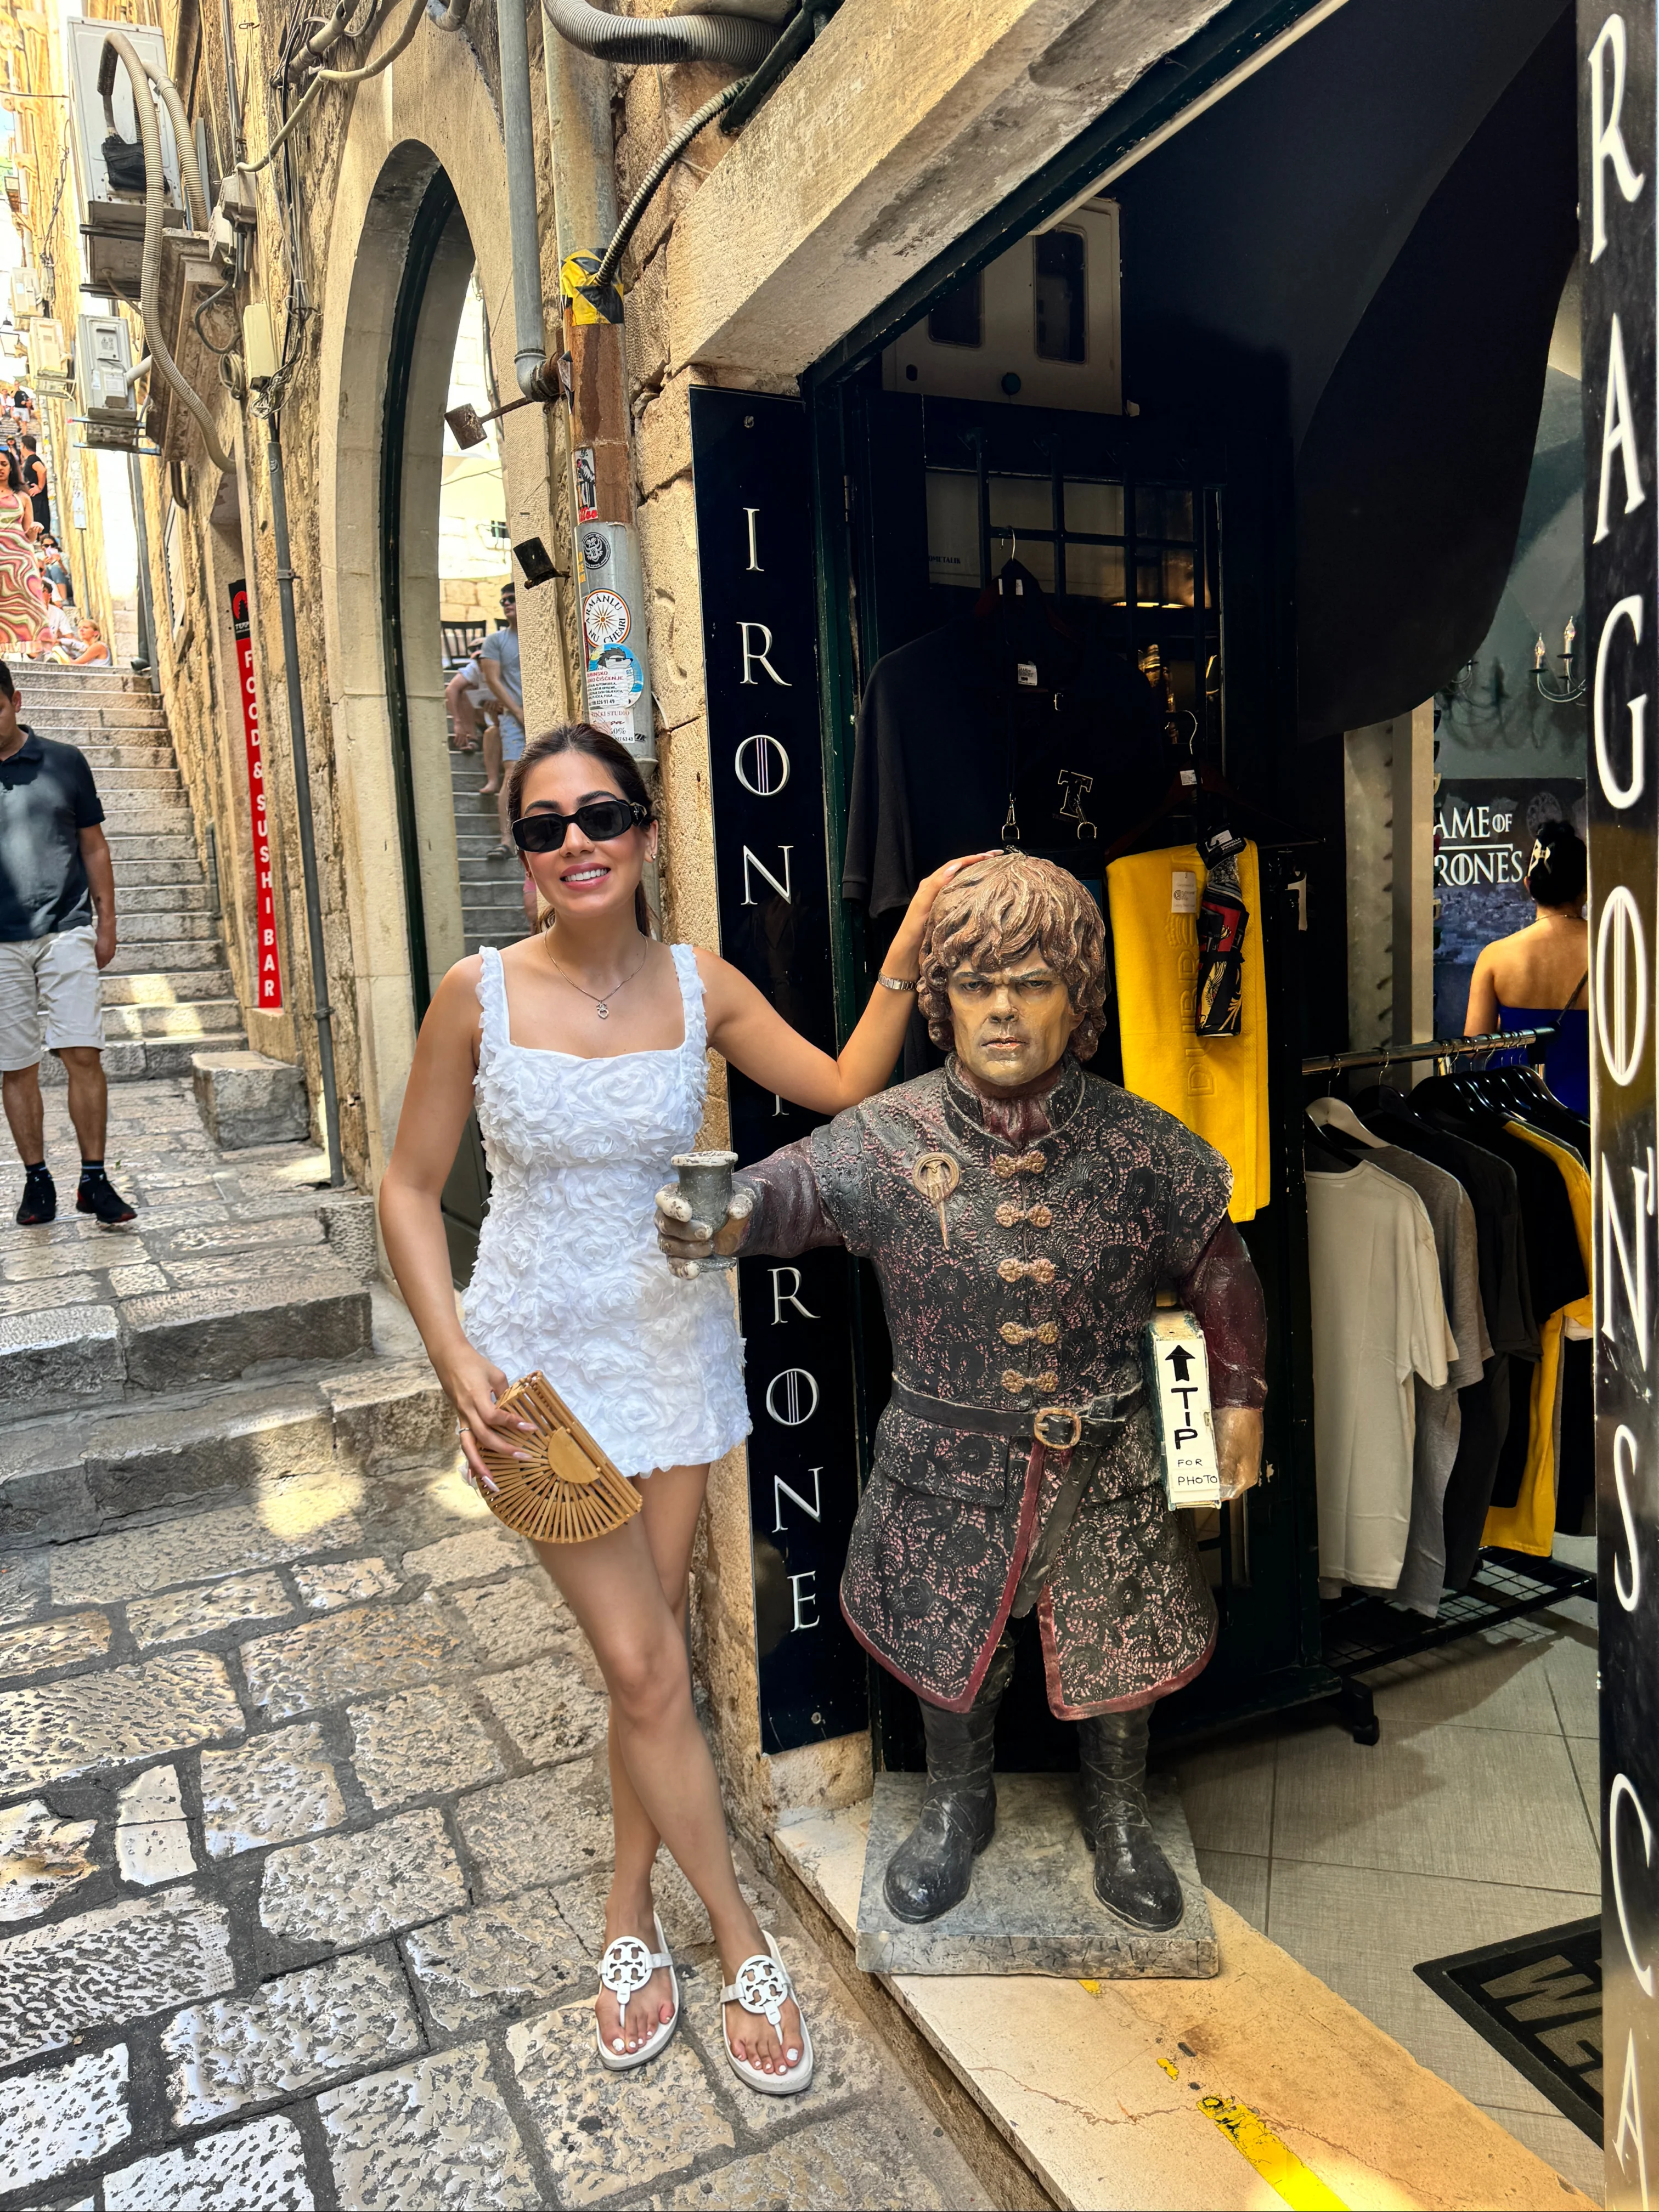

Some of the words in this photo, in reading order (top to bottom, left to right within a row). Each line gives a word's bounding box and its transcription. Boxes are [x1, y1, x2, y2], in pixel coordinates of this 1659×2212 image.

[588, 629, 600, 642] NU
[245, 650, 261, 746] FOOD
[253, 761, 263, 779] &
[1492, 813, 1513, 833] OF
[256, 794, 273, 914] SUSHI
[1434, 851, 1523, 886] RONES
[263, 928, 275, 997] BAR
[735, 507, 794, 905] IRON
[765, 1095, 825, 1632] RONE
[1171, 1387, 1198, 1450] TIP
[1177, 1458, 1203, 1467] FOR
[1178, 1474, 1218, 1486] PHOTO
